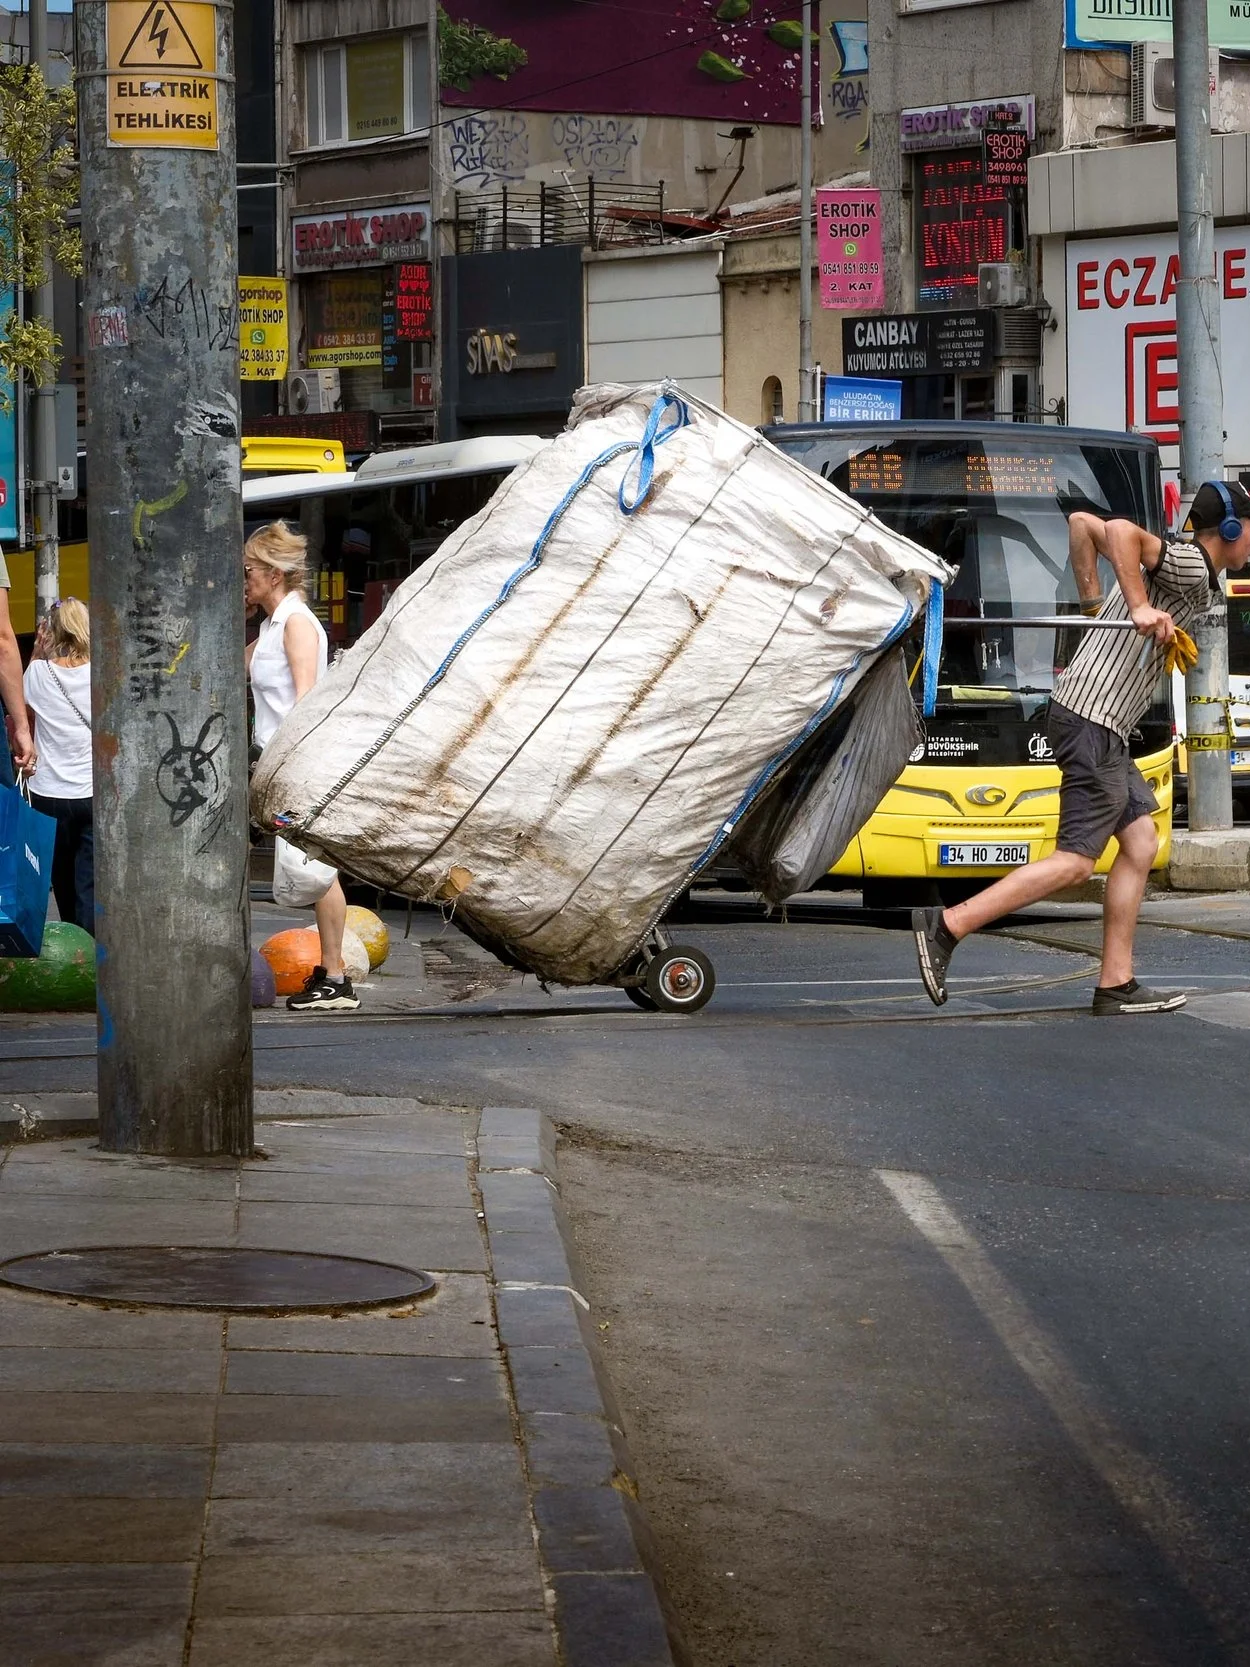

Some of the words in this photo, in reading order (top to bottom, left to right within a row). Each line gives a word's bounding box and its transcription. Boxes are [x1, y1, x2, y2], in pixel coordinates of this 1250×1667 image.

[115, 111, 212, 132] TEHLİKESİ
[902, 105, 968, 135] EROTİK
[987, 132, 1026, 147] EROTİK
[992, 147, 1023, 160] SHOP
[988, 162, 1027, 172] 3498961
[821, 199, 876, 218] EROTİK
[294, 212, 369, 251] EROTİK
[370, 211, 427, 245] SHOP
[829, 223, 870, 238] SHOP
[823, 263, 840, 275] 0541
[843, 263, 856, 275] 851
[830, 283, 841, 291] 2.
[849, 282, 873, 291] KAT
[1077, 248, 1248, 311] ECZAE
[239, 287, 283, 301] gorshop
[262, 308, 284, 324] SHOP
[854, 319, 919, 348] CANBAY
[309, 350, 381, 367] www.agorshop.com
[847, 351, 887, 372] KUYUMCU
[256, 367, 276, 376] KAT
[829, 406, 850, 419] BİR
[854, 408, 895, 421] ERİKLİ
[927, 741, 980, 752] BÜYÜKŞEHİR
[1235, 751, 1246, 764] 34
[948, 846, 964, 863] 34
[995, 846, 1026, 863] 2804
